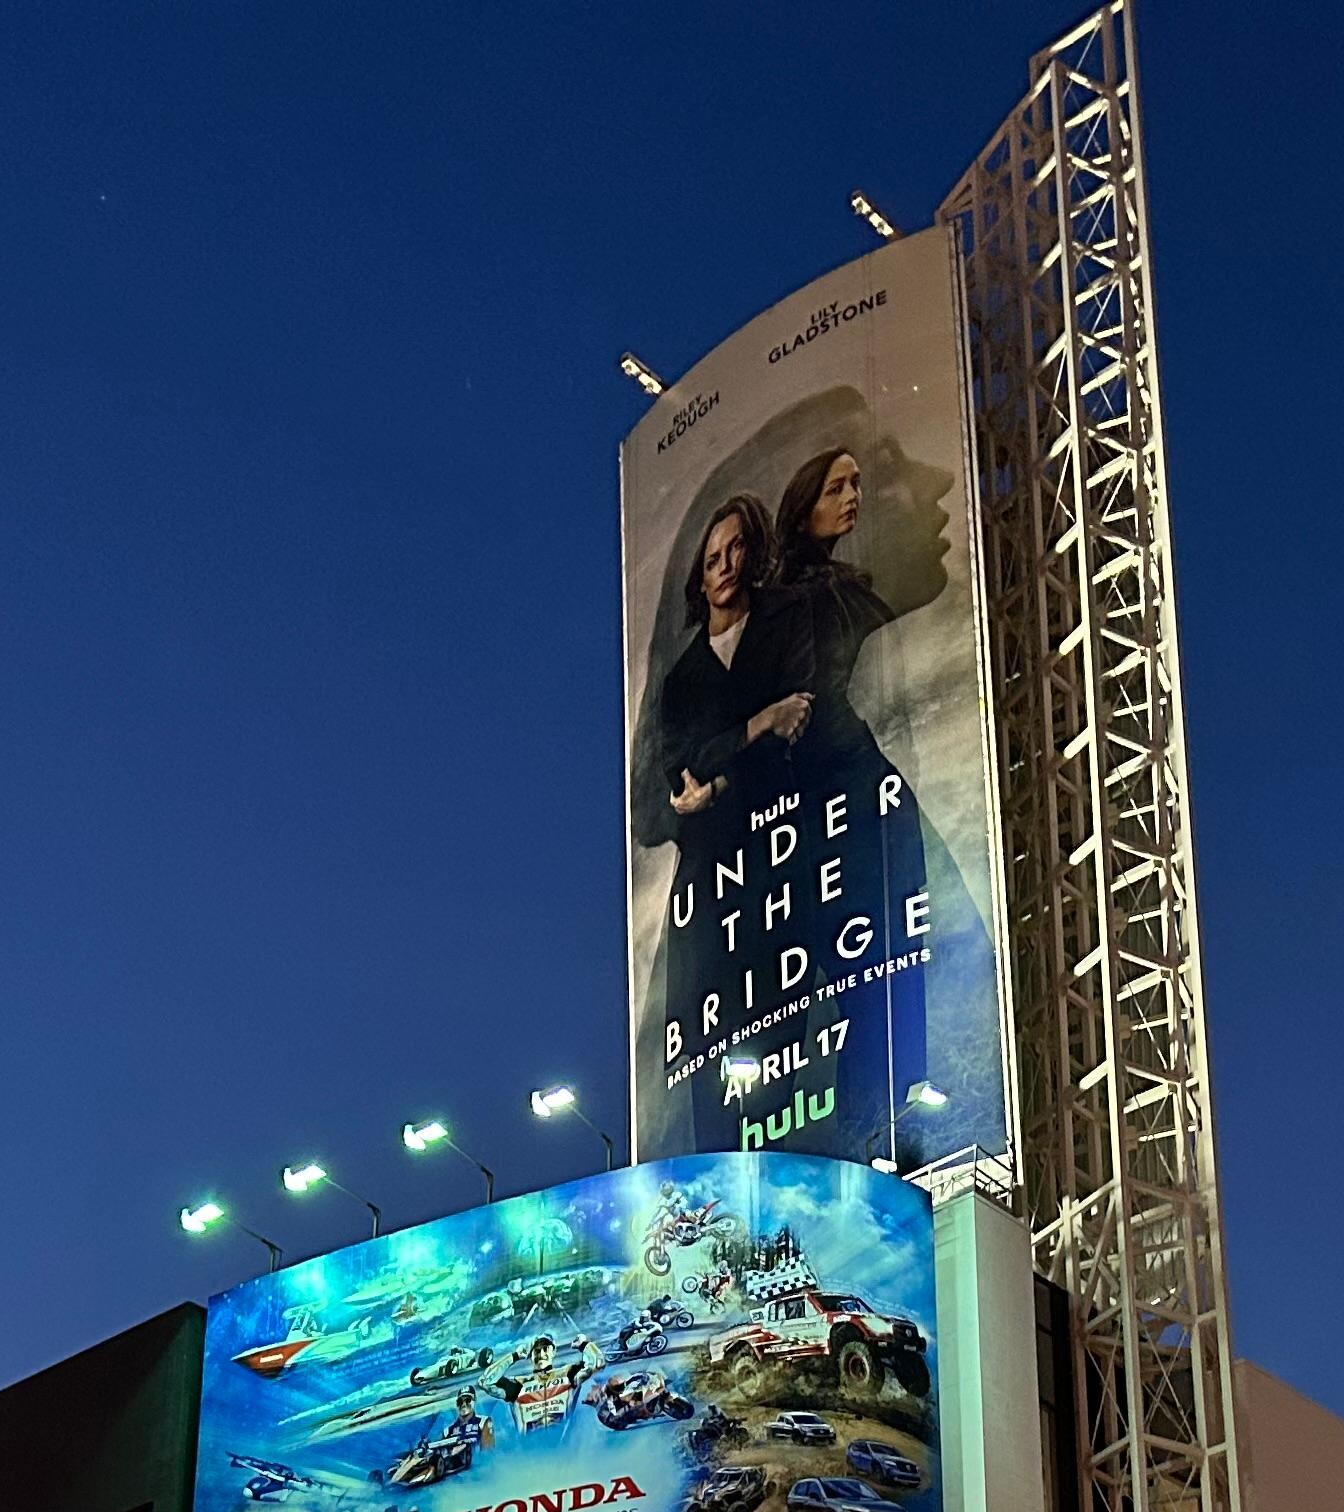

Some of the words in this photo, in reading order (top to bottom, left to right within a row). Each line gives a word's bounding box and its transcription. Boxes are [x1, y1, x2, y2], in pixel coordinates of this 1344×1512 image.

[768, 290, 888, 364] GLADSTONE
[810, 301, 839, 325] LILY
[656, 391, 720, 455] KEOUGH
[672, 393, 703, 427] RILEY
[750, 792, 800, 832] hulu
[672, 774, 903, 929] UNDER
[721, 857, 843, 952] THE
[666, 892, 931, 1063] BRIDGE
[667, 1055, 705, 1090] BASED
[708, 1038, 728, 1060] ON
[732, 996, 811, 1046] SHOCKING
[816, 974, 858, 1002] TRUE
[864, 947, 932, 983] EVENTS
[723, 1041, 809, 1106] APRIL
[816, 1019, 850, 1057] 17
[743, 1087, 835, 1152] hulu
